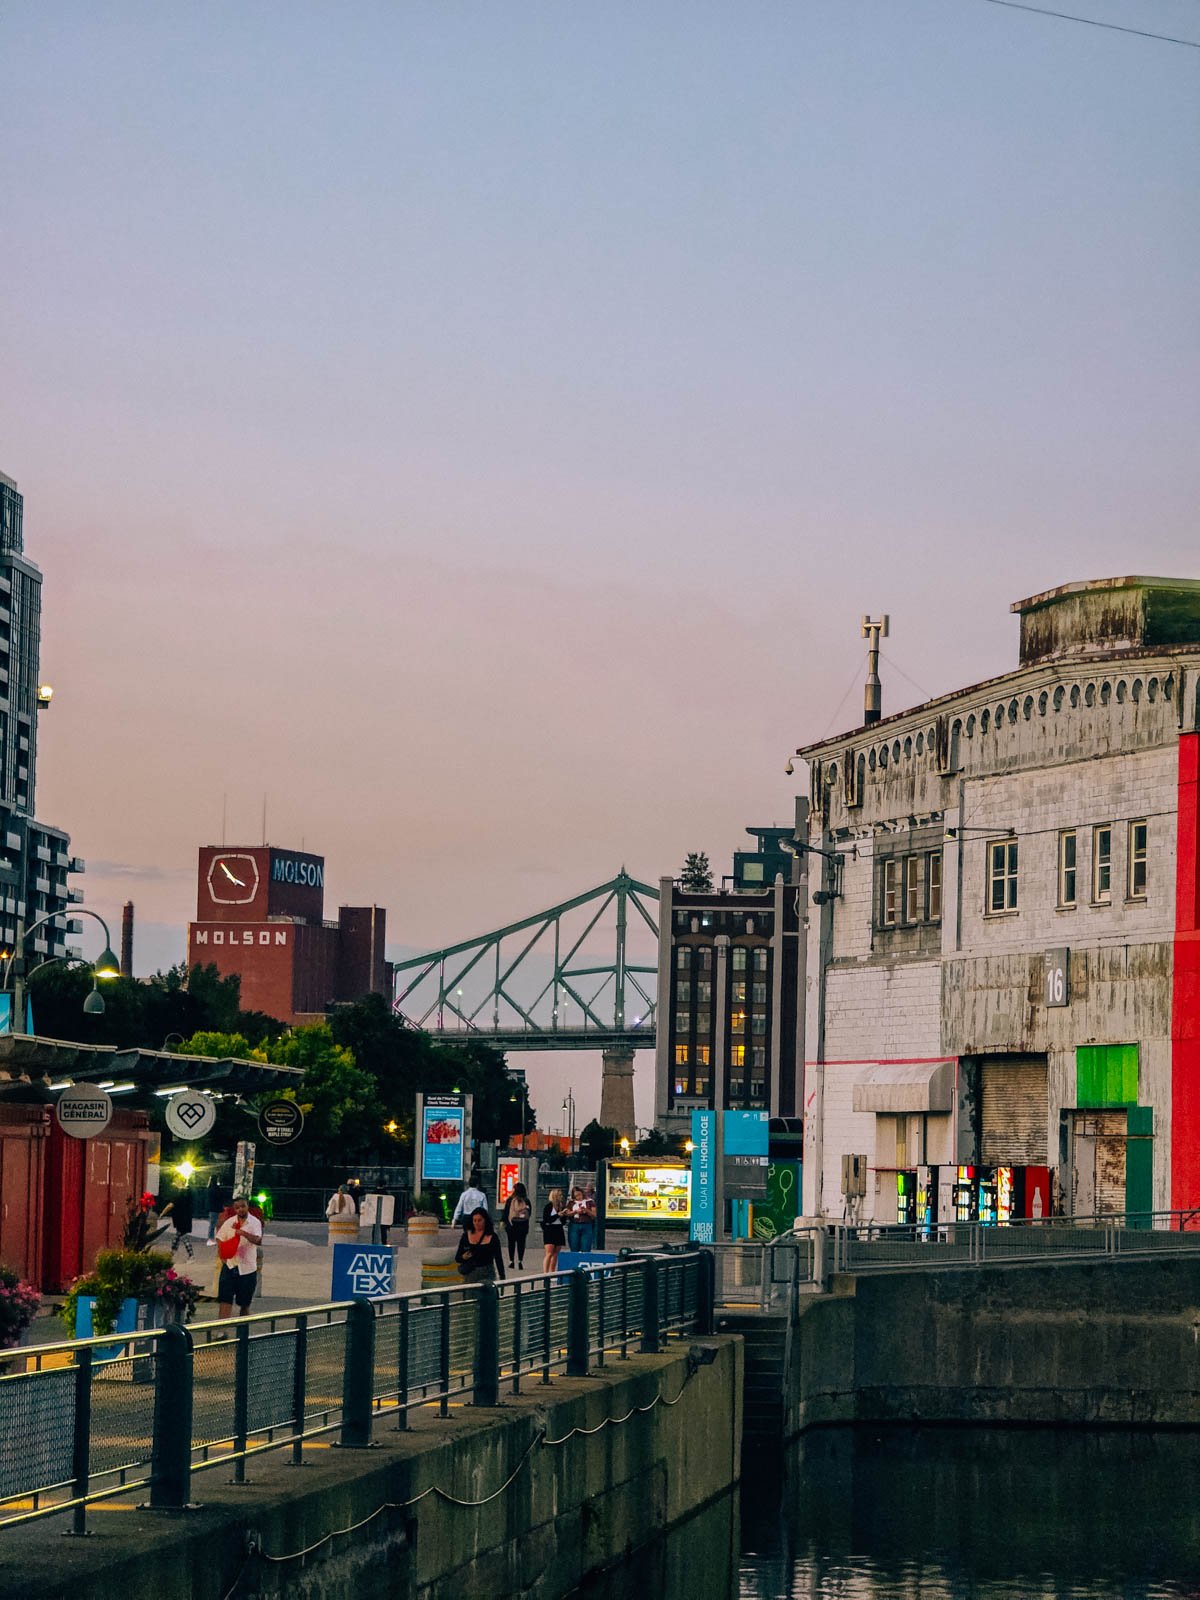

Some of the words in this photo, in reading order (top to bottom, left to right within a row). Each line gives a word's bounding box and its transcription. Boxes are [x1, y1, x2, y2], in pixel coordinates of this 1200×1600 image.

[272, 858, 324, 888] MOLSON
[196, 930, 287, 945] MOLSON
[1047, 968, 1063, 1002] 16
[63, 1109, 105, 1119] GÉNÉRAL
[700, 1115, 709, 1169] L'HORLOGE
[700, 1171, 708, 1185] DE
[699, 1187, 709, 1209] QUAI
[347, 1253, 392, 1276] AM
[353, 1274, 391, 1294] EX
